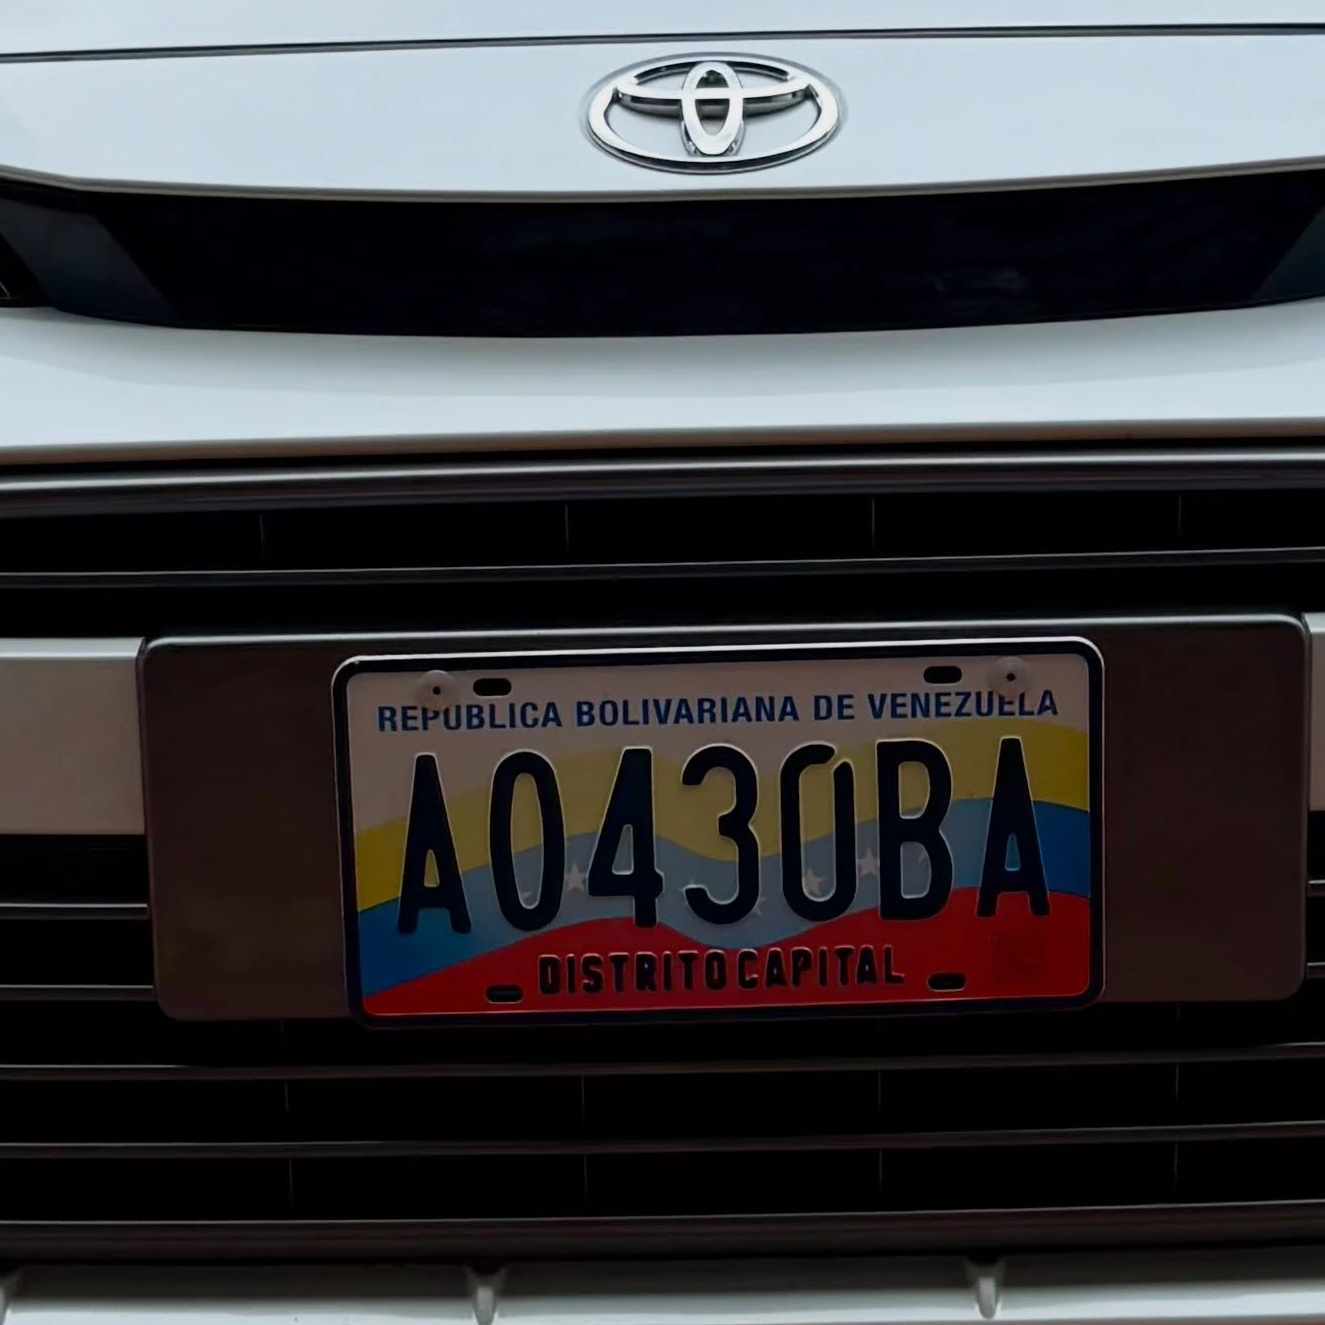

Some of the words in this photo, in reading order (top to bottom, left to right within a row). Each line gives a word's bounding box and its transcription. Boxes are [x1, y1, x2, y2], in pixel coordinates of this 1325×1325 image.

[576, 695, 800, 727] BOLIVARIANA
[813, 694, 855, 721] DE
[867, 689, 1059, 720] VENEZUELA
